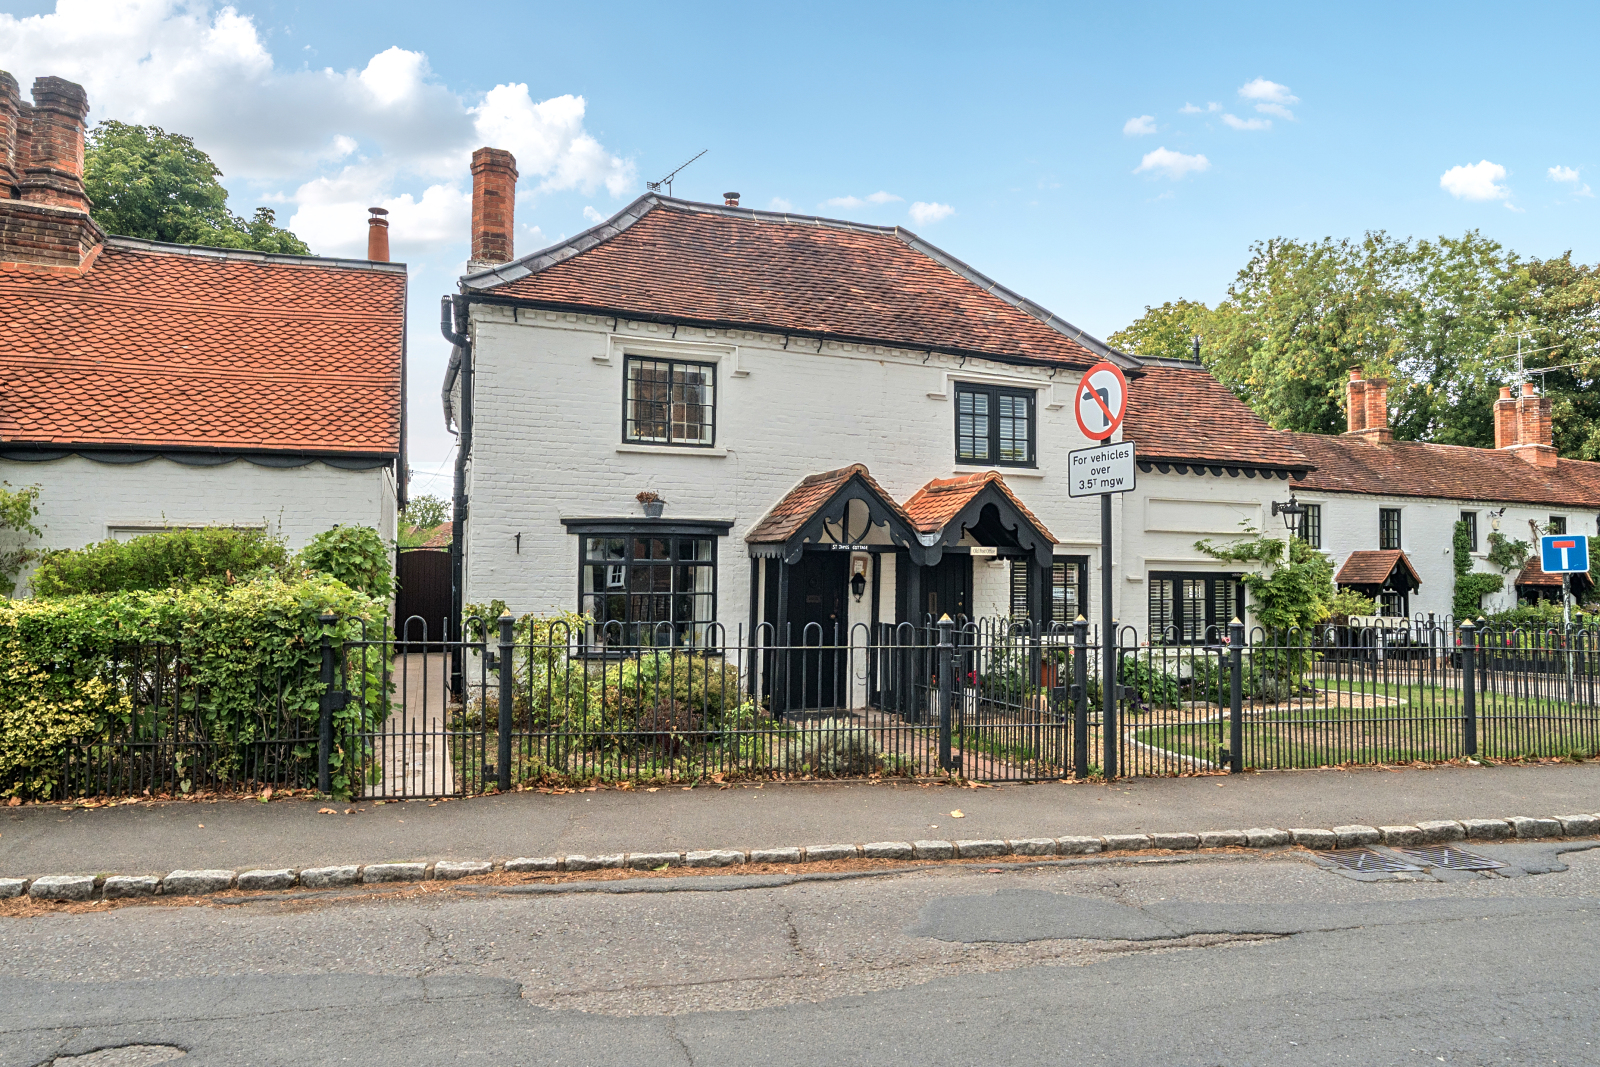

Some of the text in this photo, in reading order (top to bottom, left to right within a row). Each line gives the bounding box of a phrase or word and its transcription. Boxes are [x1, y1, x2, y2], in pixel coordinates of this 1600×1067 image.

[1073, 450, 1129, 465] For vehicles
[1091, 466, 1110, 475] over
[1079, 477, 1123, 489] 3.5T mgw
